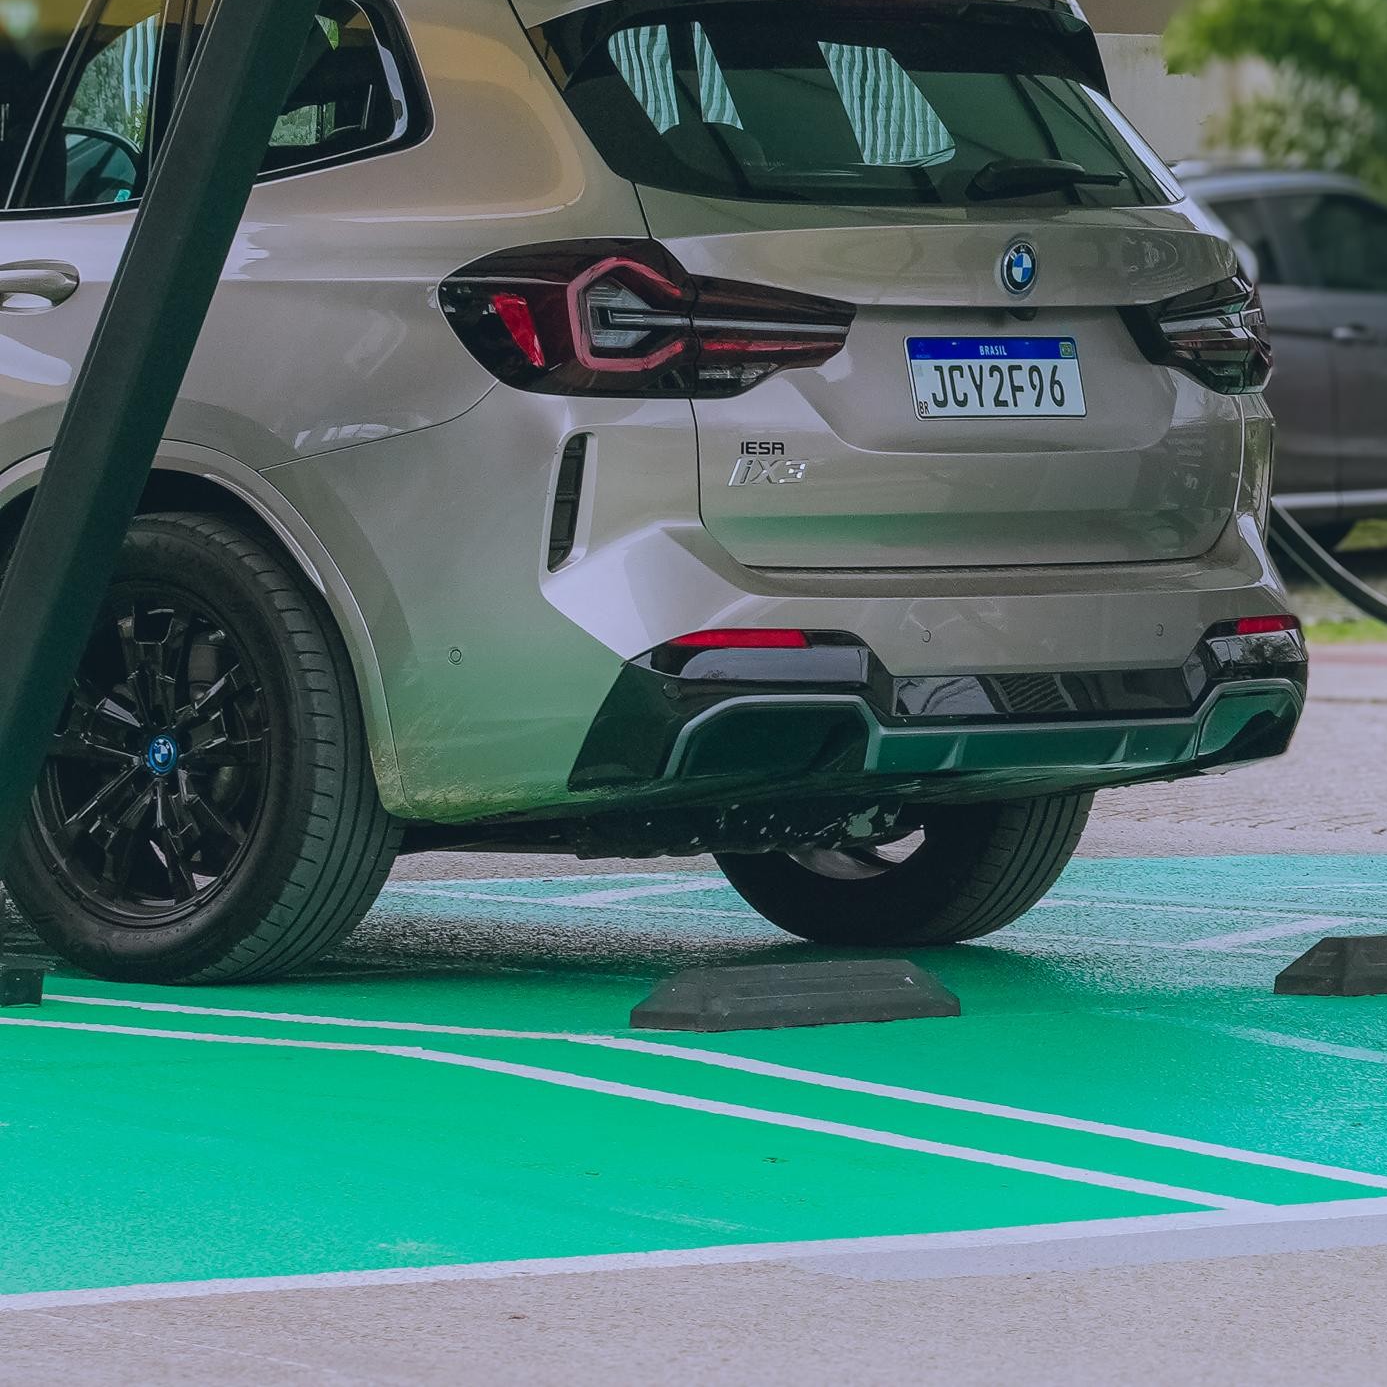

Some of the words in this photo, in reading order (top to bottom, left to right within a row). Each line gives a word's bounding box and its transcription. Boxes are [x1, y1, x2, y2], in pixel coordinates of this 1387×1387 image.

[978, 345, 1008, 356] BRASIL
[931, 364, 1066, 409] JCY2F96
[918, 400, 930, 415] BR
[740, 441, 785, 455] IESA
